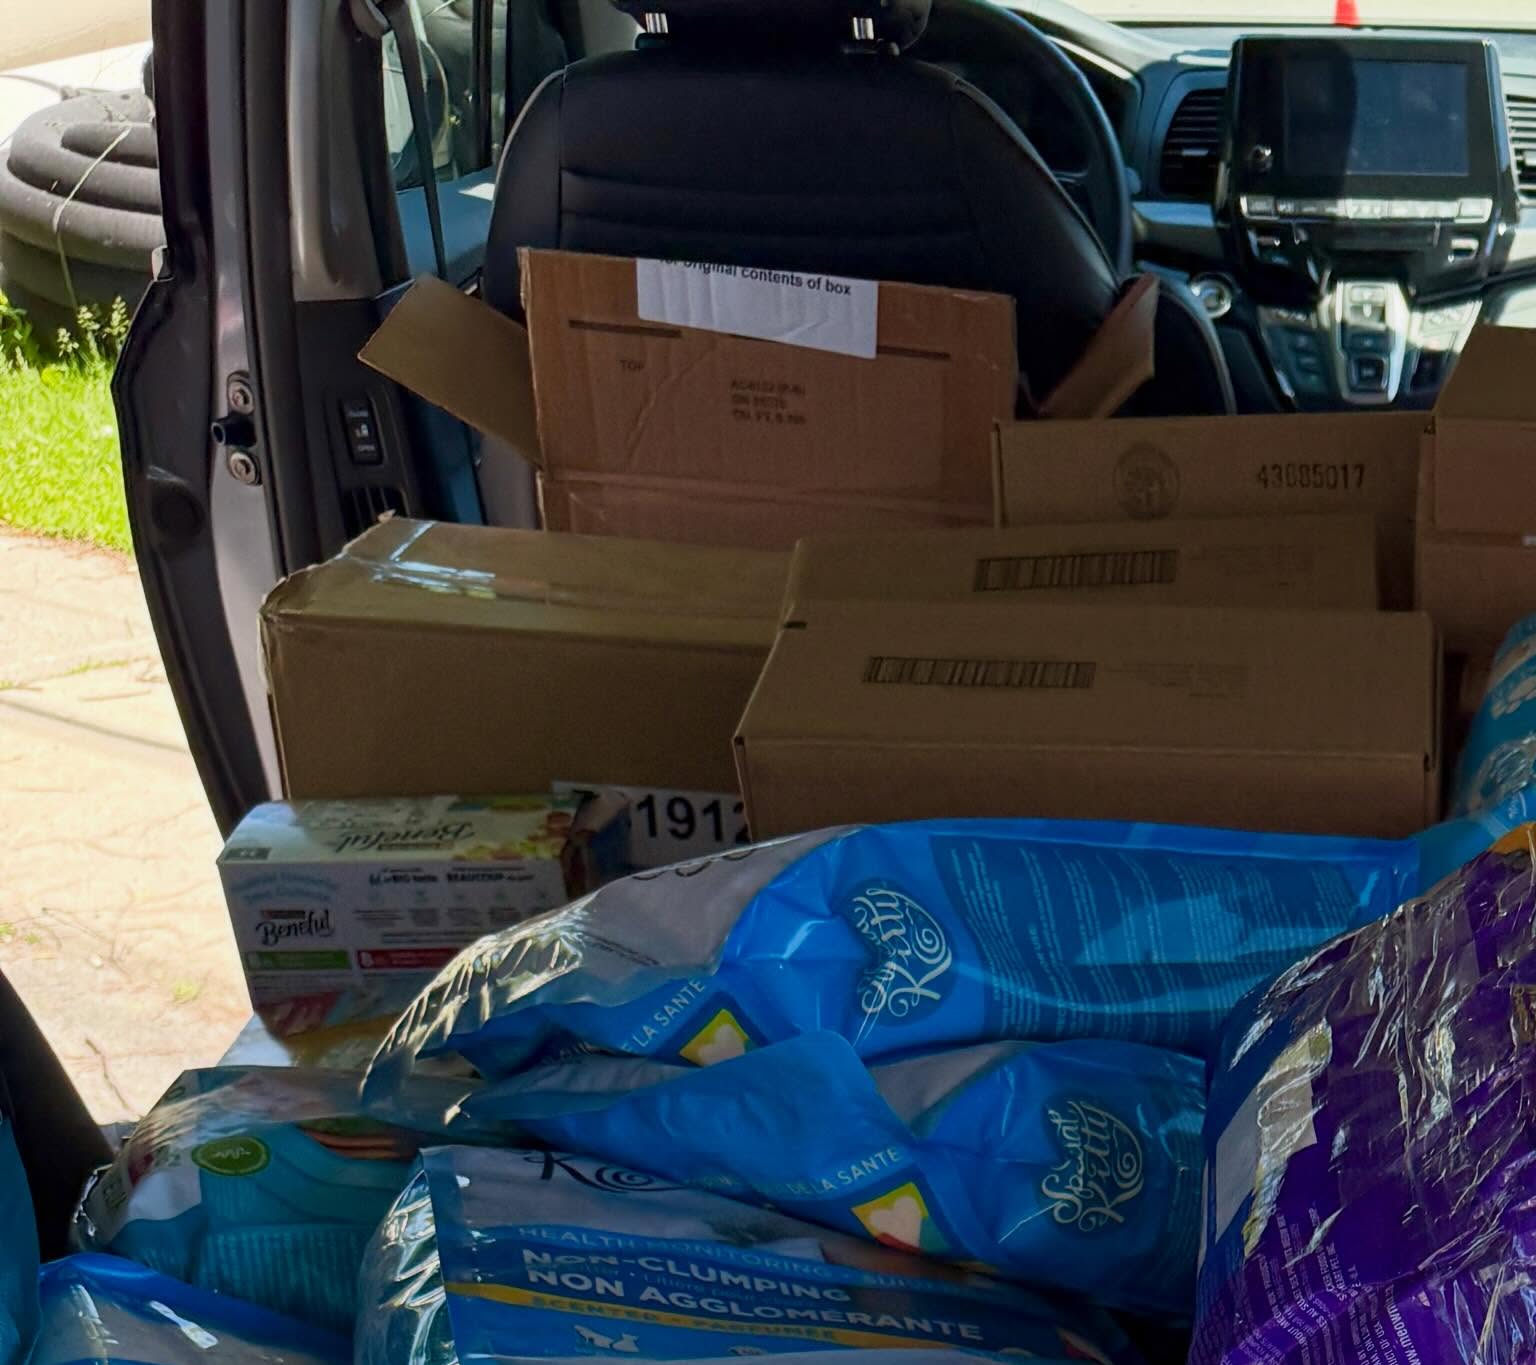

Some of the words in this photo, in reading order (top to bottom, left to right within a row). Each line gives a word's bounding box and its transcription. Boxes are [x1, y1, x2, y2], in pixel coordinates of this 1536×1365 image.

[741, 267, 802, 287] contents
[807, 277, 821, 290] of
[825, 277, 852, 296] box
[256, 909, 332, 945] Beneful
[836, 1144, 902, 1190] SANTÉ
[522, 1248, 851, 1302] NON-CLUMPING
[527, 1267, 625, 1298] NON
